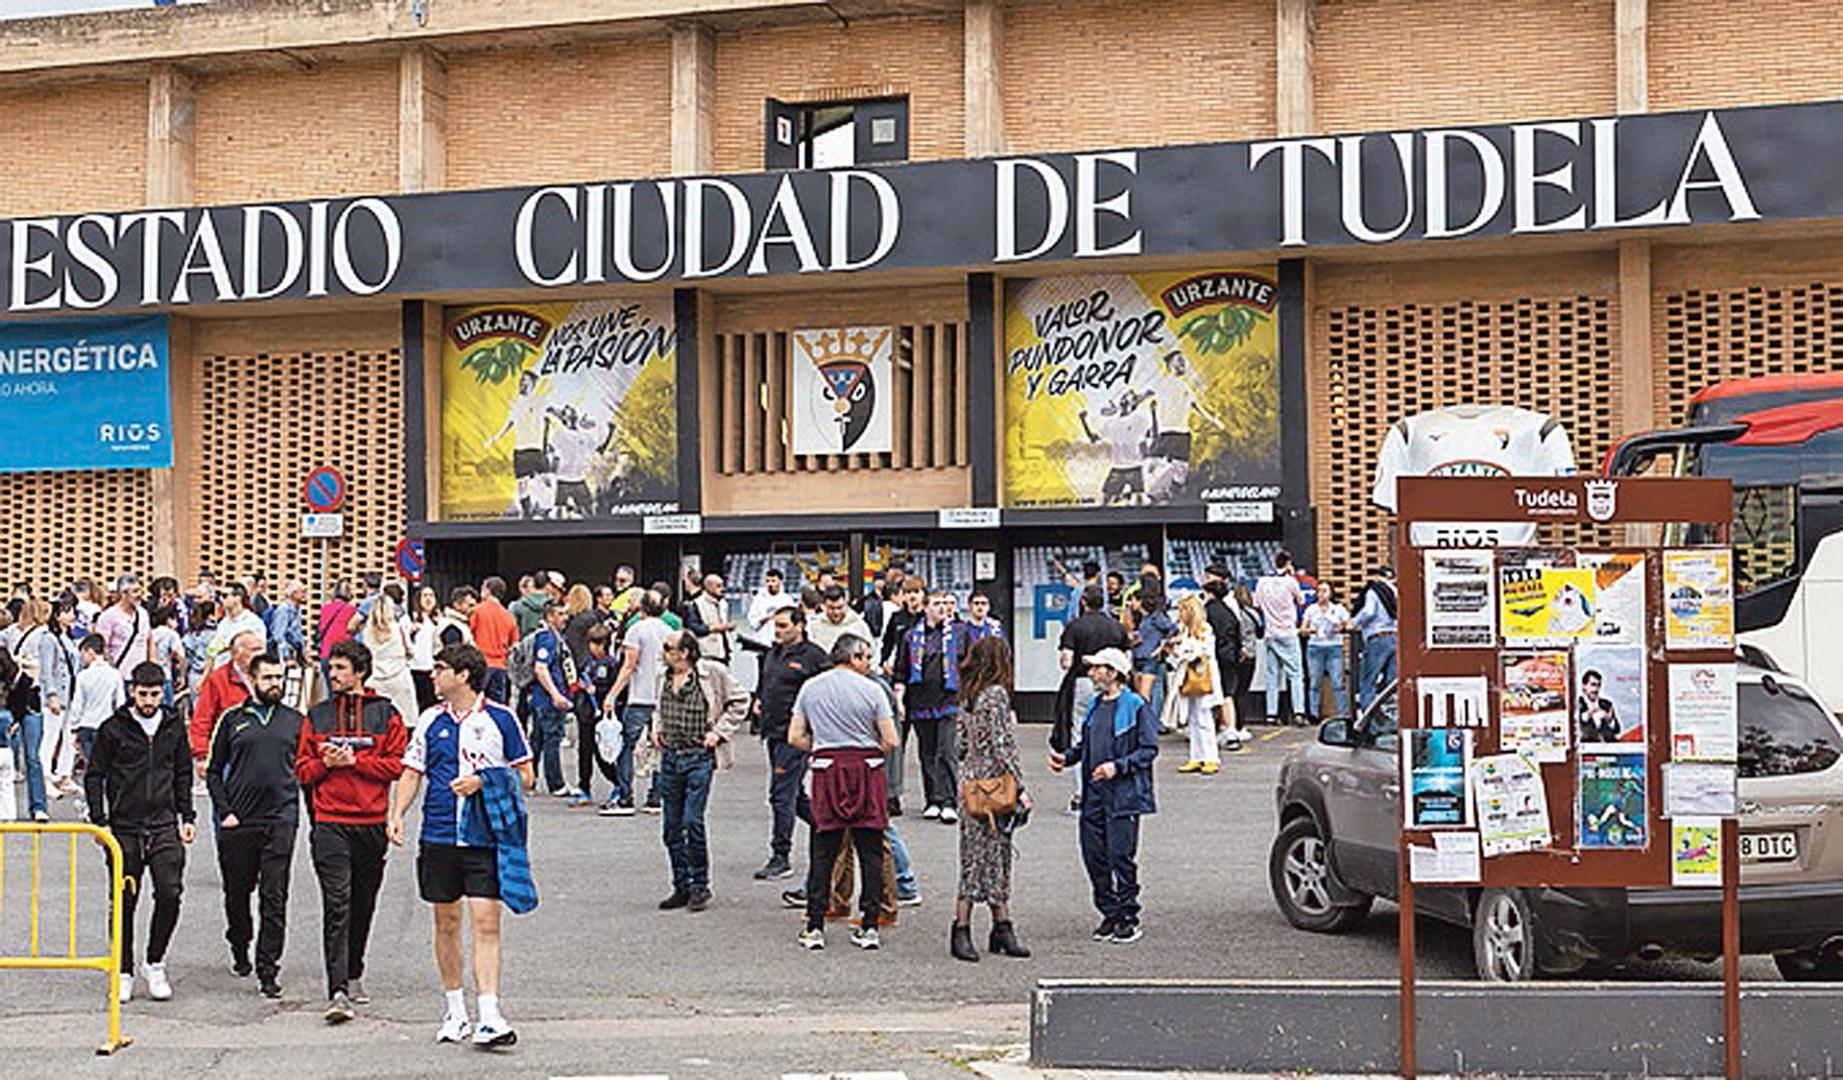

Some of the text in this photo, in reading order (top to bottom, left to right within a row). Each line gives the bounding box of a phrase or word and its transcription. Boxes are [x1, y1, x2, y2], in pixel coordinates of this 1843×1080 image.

[9, 110, 1762, 312] ESTADIO CIUDAD DE TUDELA
[1035, 290, 1114, 337] VALOR
[1172, 277, 1274, 307] URZANTE
[456, 313, 542, 342] URZANTE
[541, 317, 677, 375] LA PASIÓN
[1009, 311, 1165, 375] PUNDONOR
[1026, 354, 1137, 400] Y GARRA
[1514, 489, 1578, 507] Tudela
[1758, 837, 1792, 855] DTC
